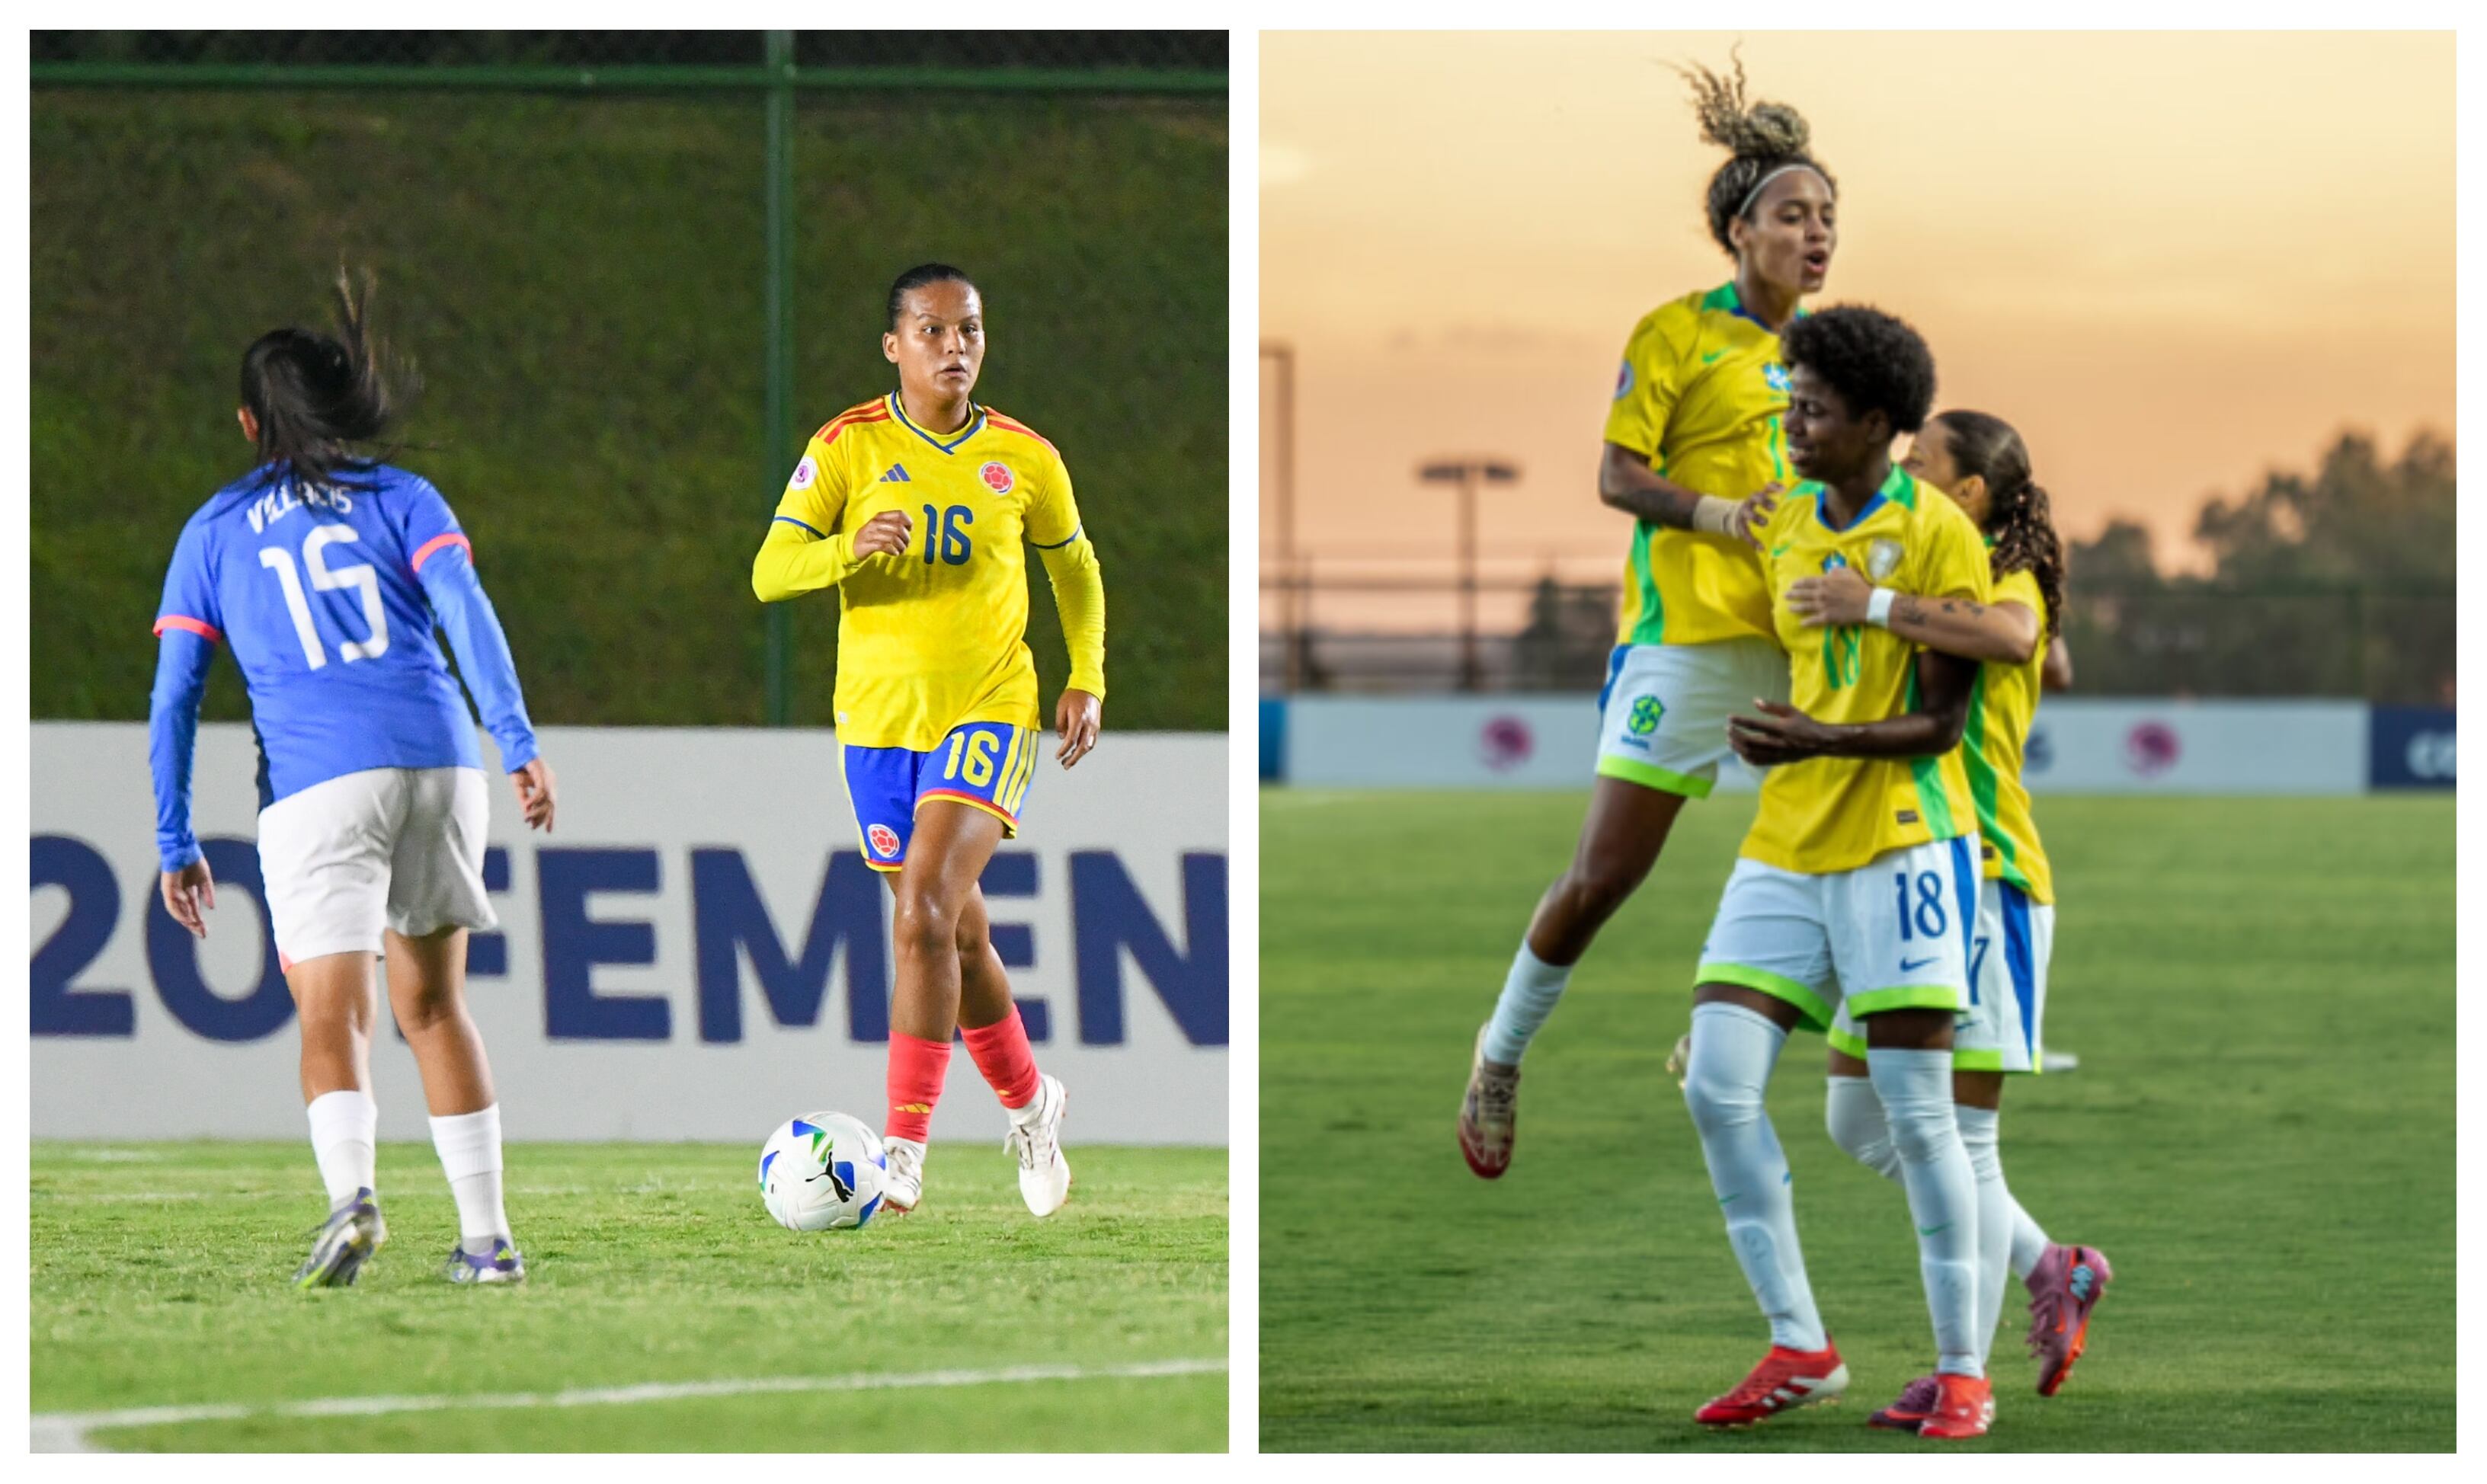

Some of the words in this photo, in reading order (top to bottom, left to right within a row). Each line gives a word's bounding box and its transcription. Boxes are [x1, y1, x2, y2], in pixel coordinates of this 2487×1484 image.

[923, 504, 974, 566] 16
[258, 523, 389, 671] 15
[943, 730, 1000, 788] 16
[30, 833, 299, 1042] 20
[392, 846, 1229, 1047] EMN
[1895, 870, 1948, 942] 18
